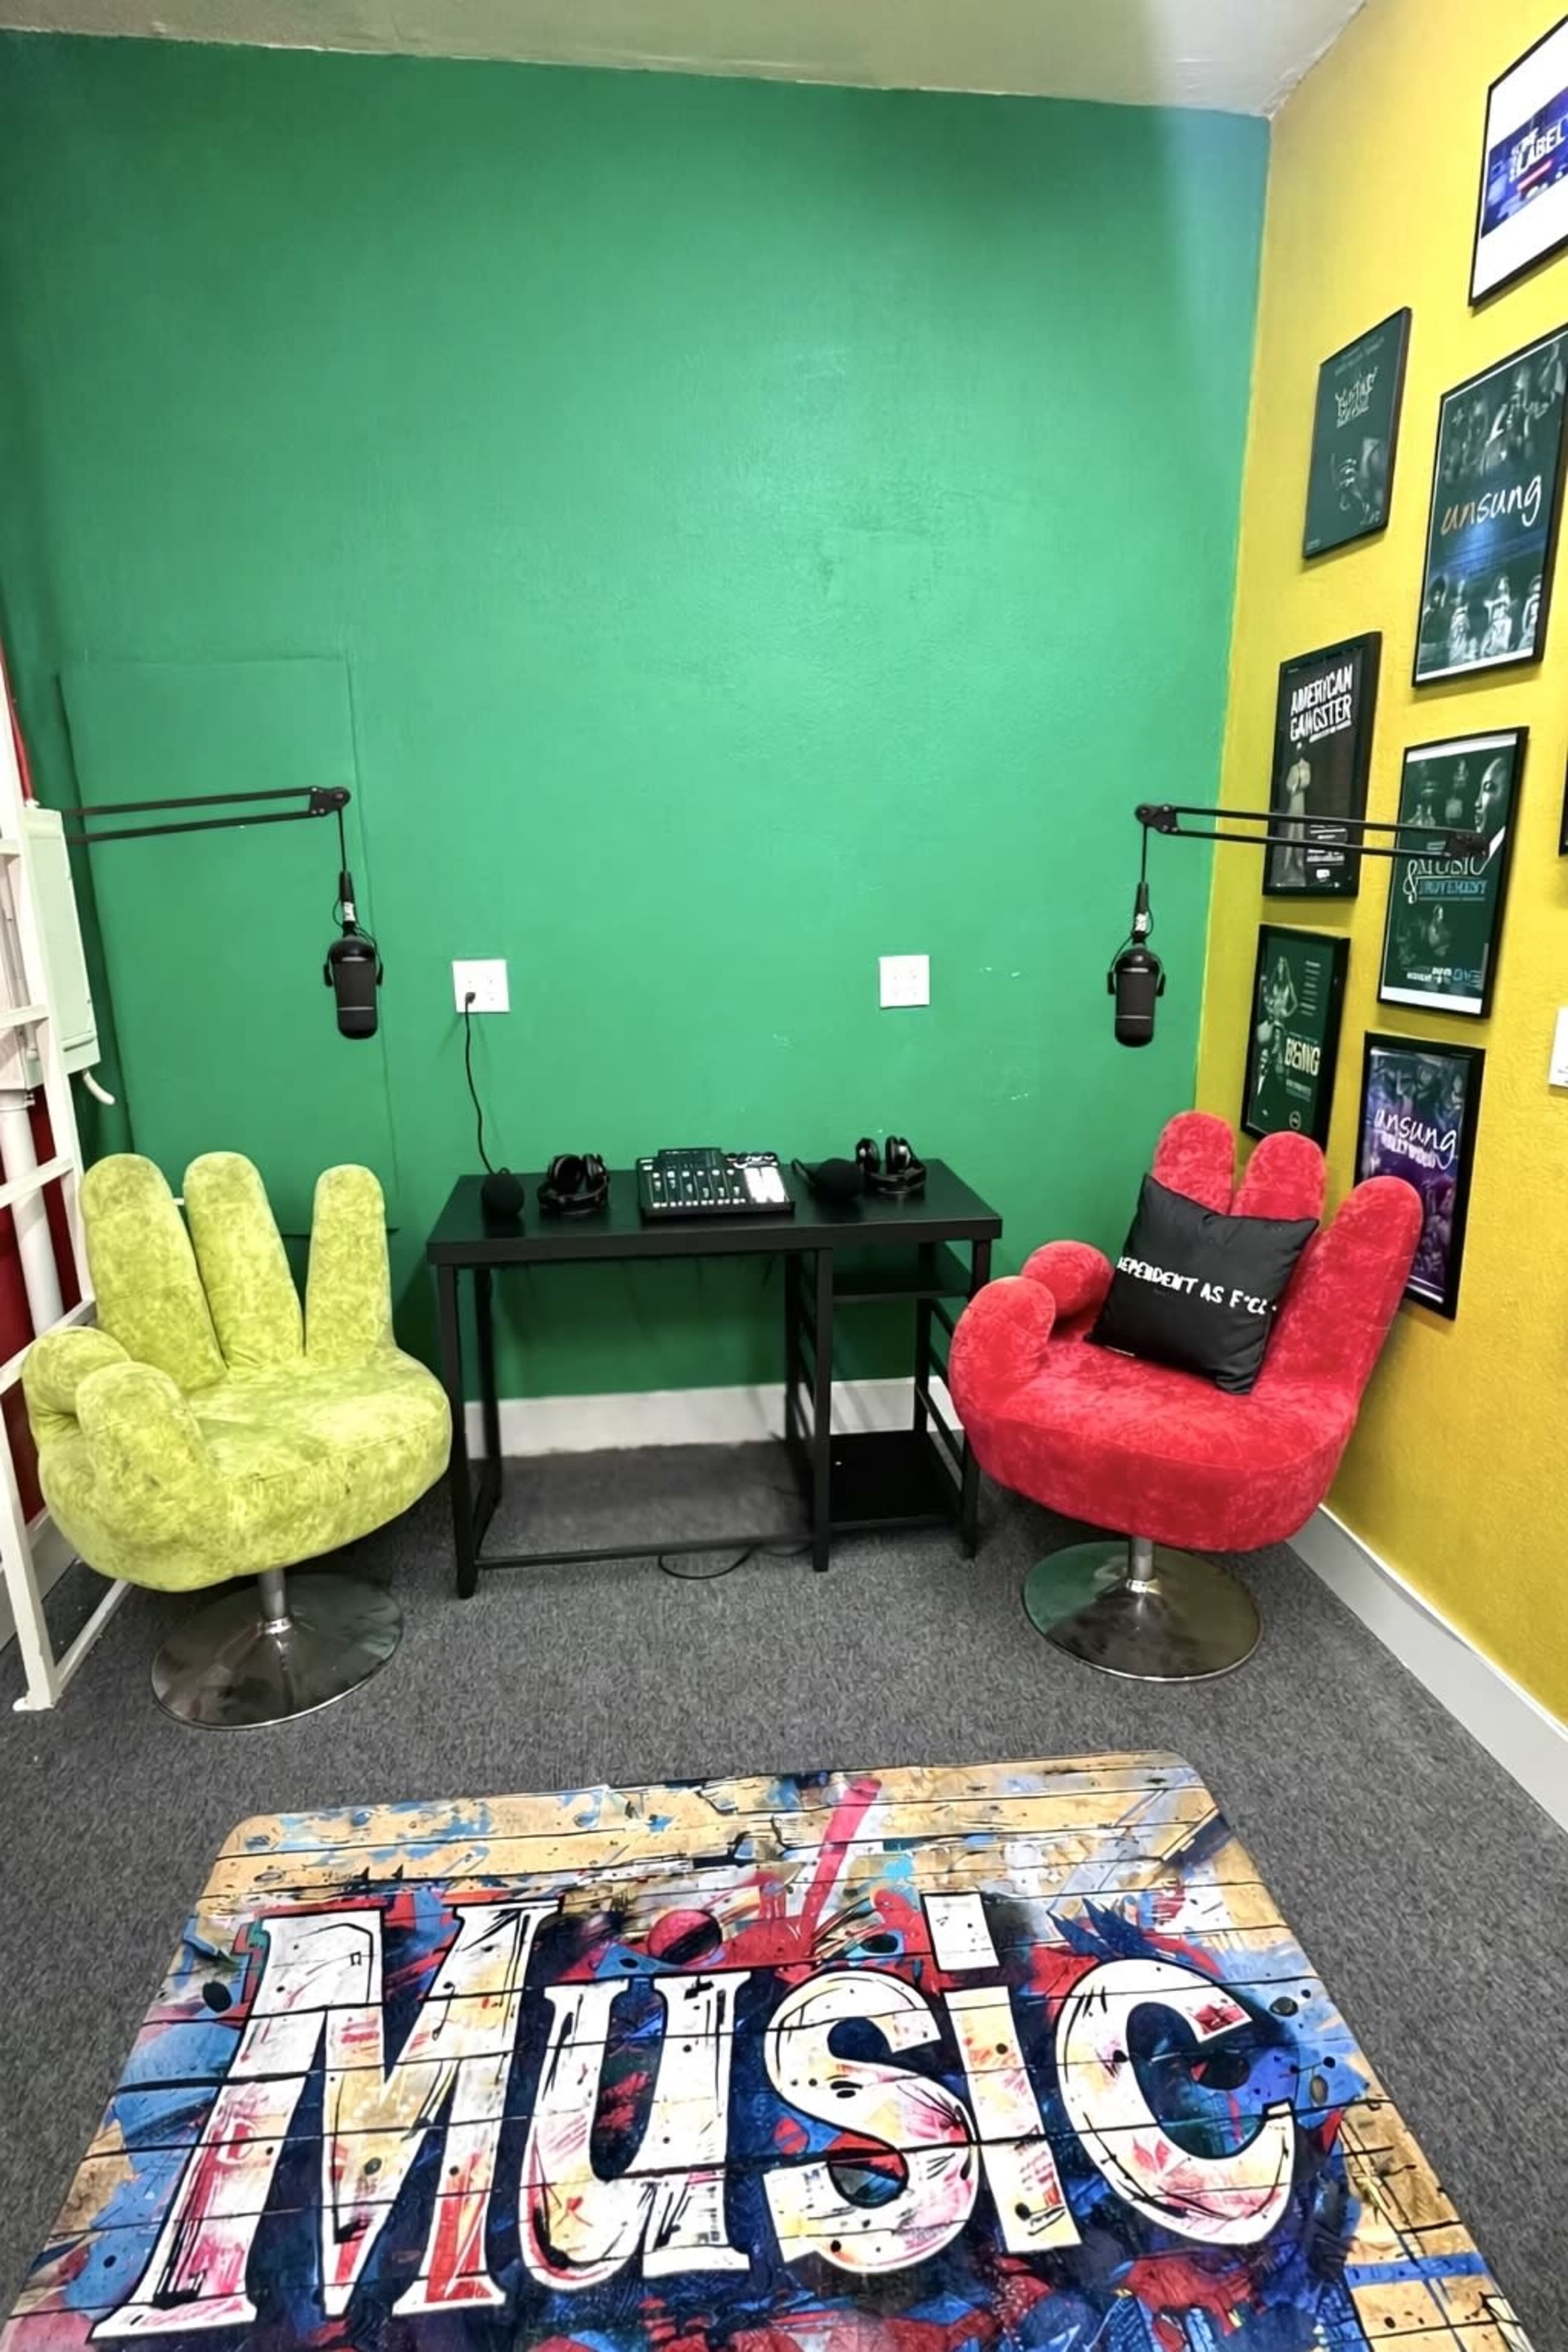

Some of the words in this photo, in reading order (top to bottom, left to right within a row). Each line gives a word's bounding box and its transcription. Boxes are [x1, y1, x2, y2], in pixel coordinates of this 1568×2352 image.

[1515, 122, 1566, 179] LABEL
[1441, 475, 1541, 536] unsung
[1291, 663, 1353, 717] AMERICAN
[1291, 694, 1352, 742] GANGSTER
[1285, 1037, 1321, 1076] BEING
[1374, 1108, 1457, 1170] unsung
[1204, 1283, 1225, 1303] AS
